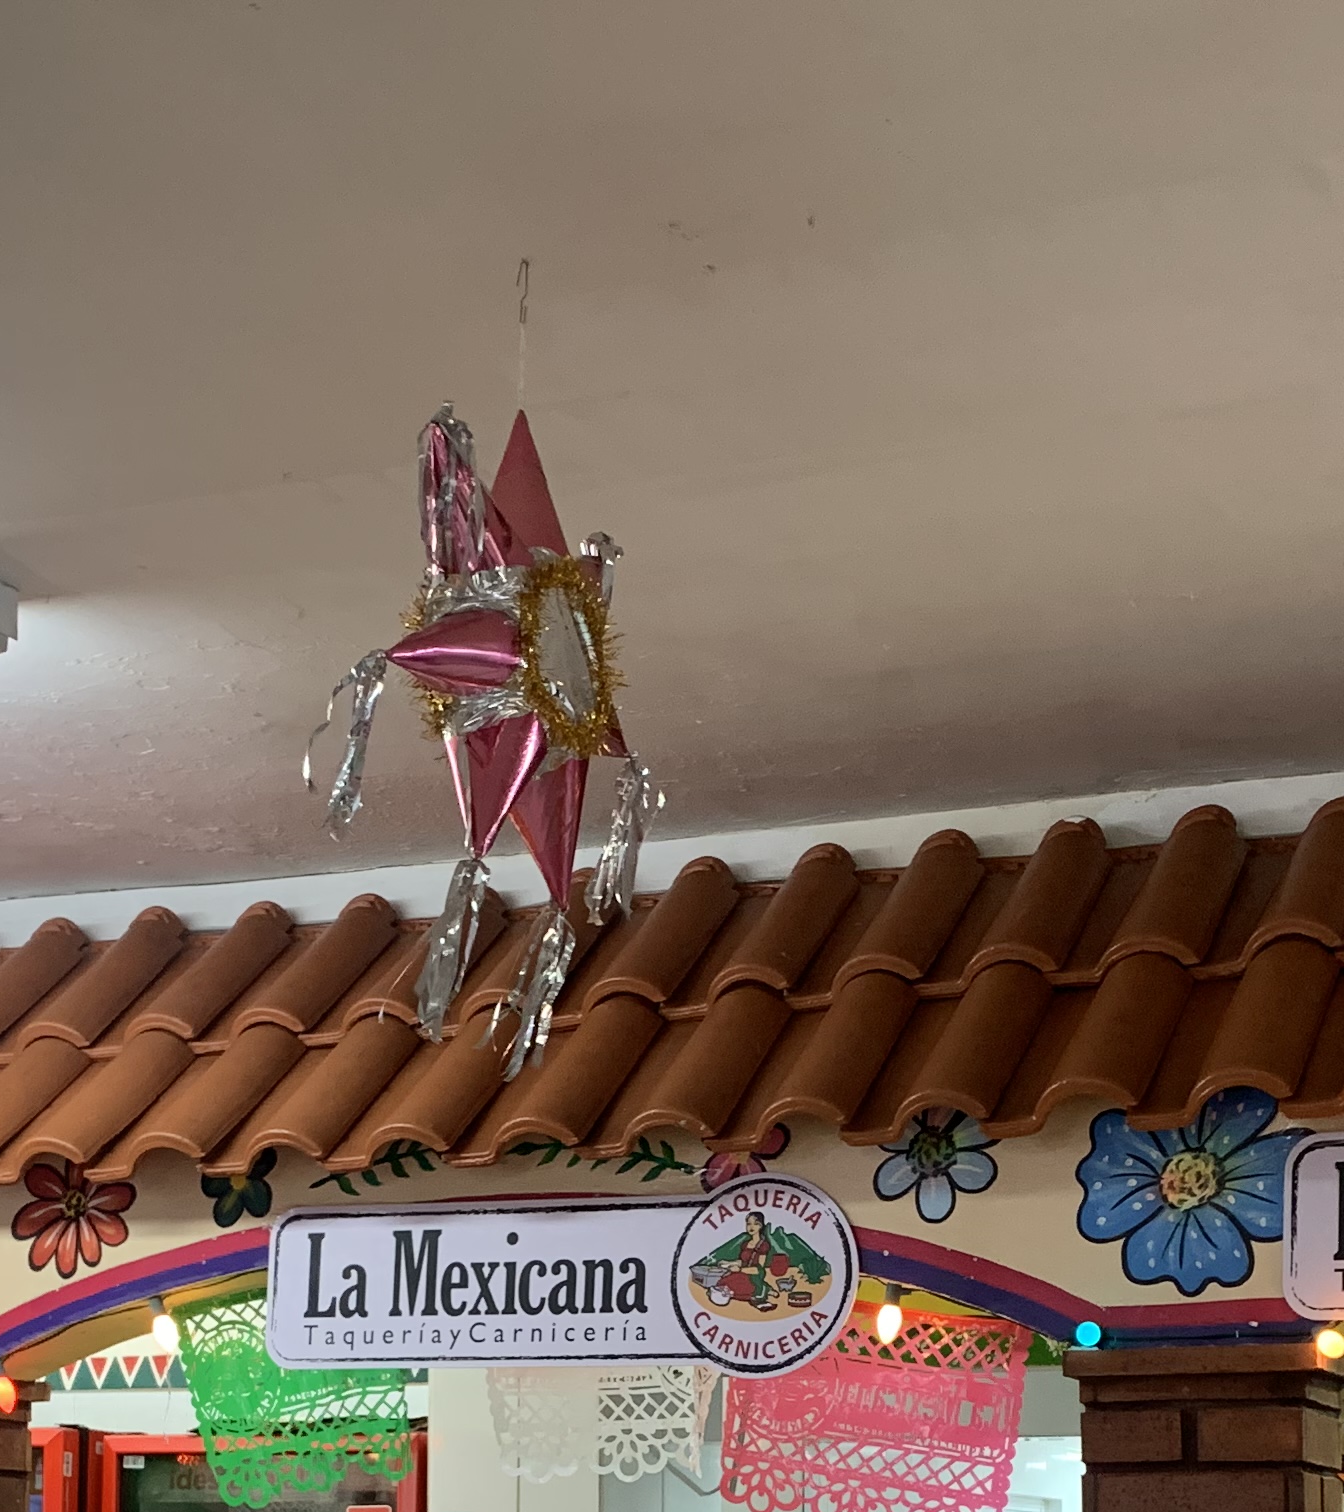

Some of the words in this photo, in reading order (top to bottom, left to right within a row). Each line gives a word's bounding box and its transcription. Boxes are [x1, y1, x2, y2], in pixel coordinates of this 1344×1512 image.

[701, 1188, 823, 1232] TAQUERIA
[304, 1232, 368, 1319] La
[389, 1229, 648, 1317] Mexicana
[692, 1306, 829, 1360] CARNICERIA
